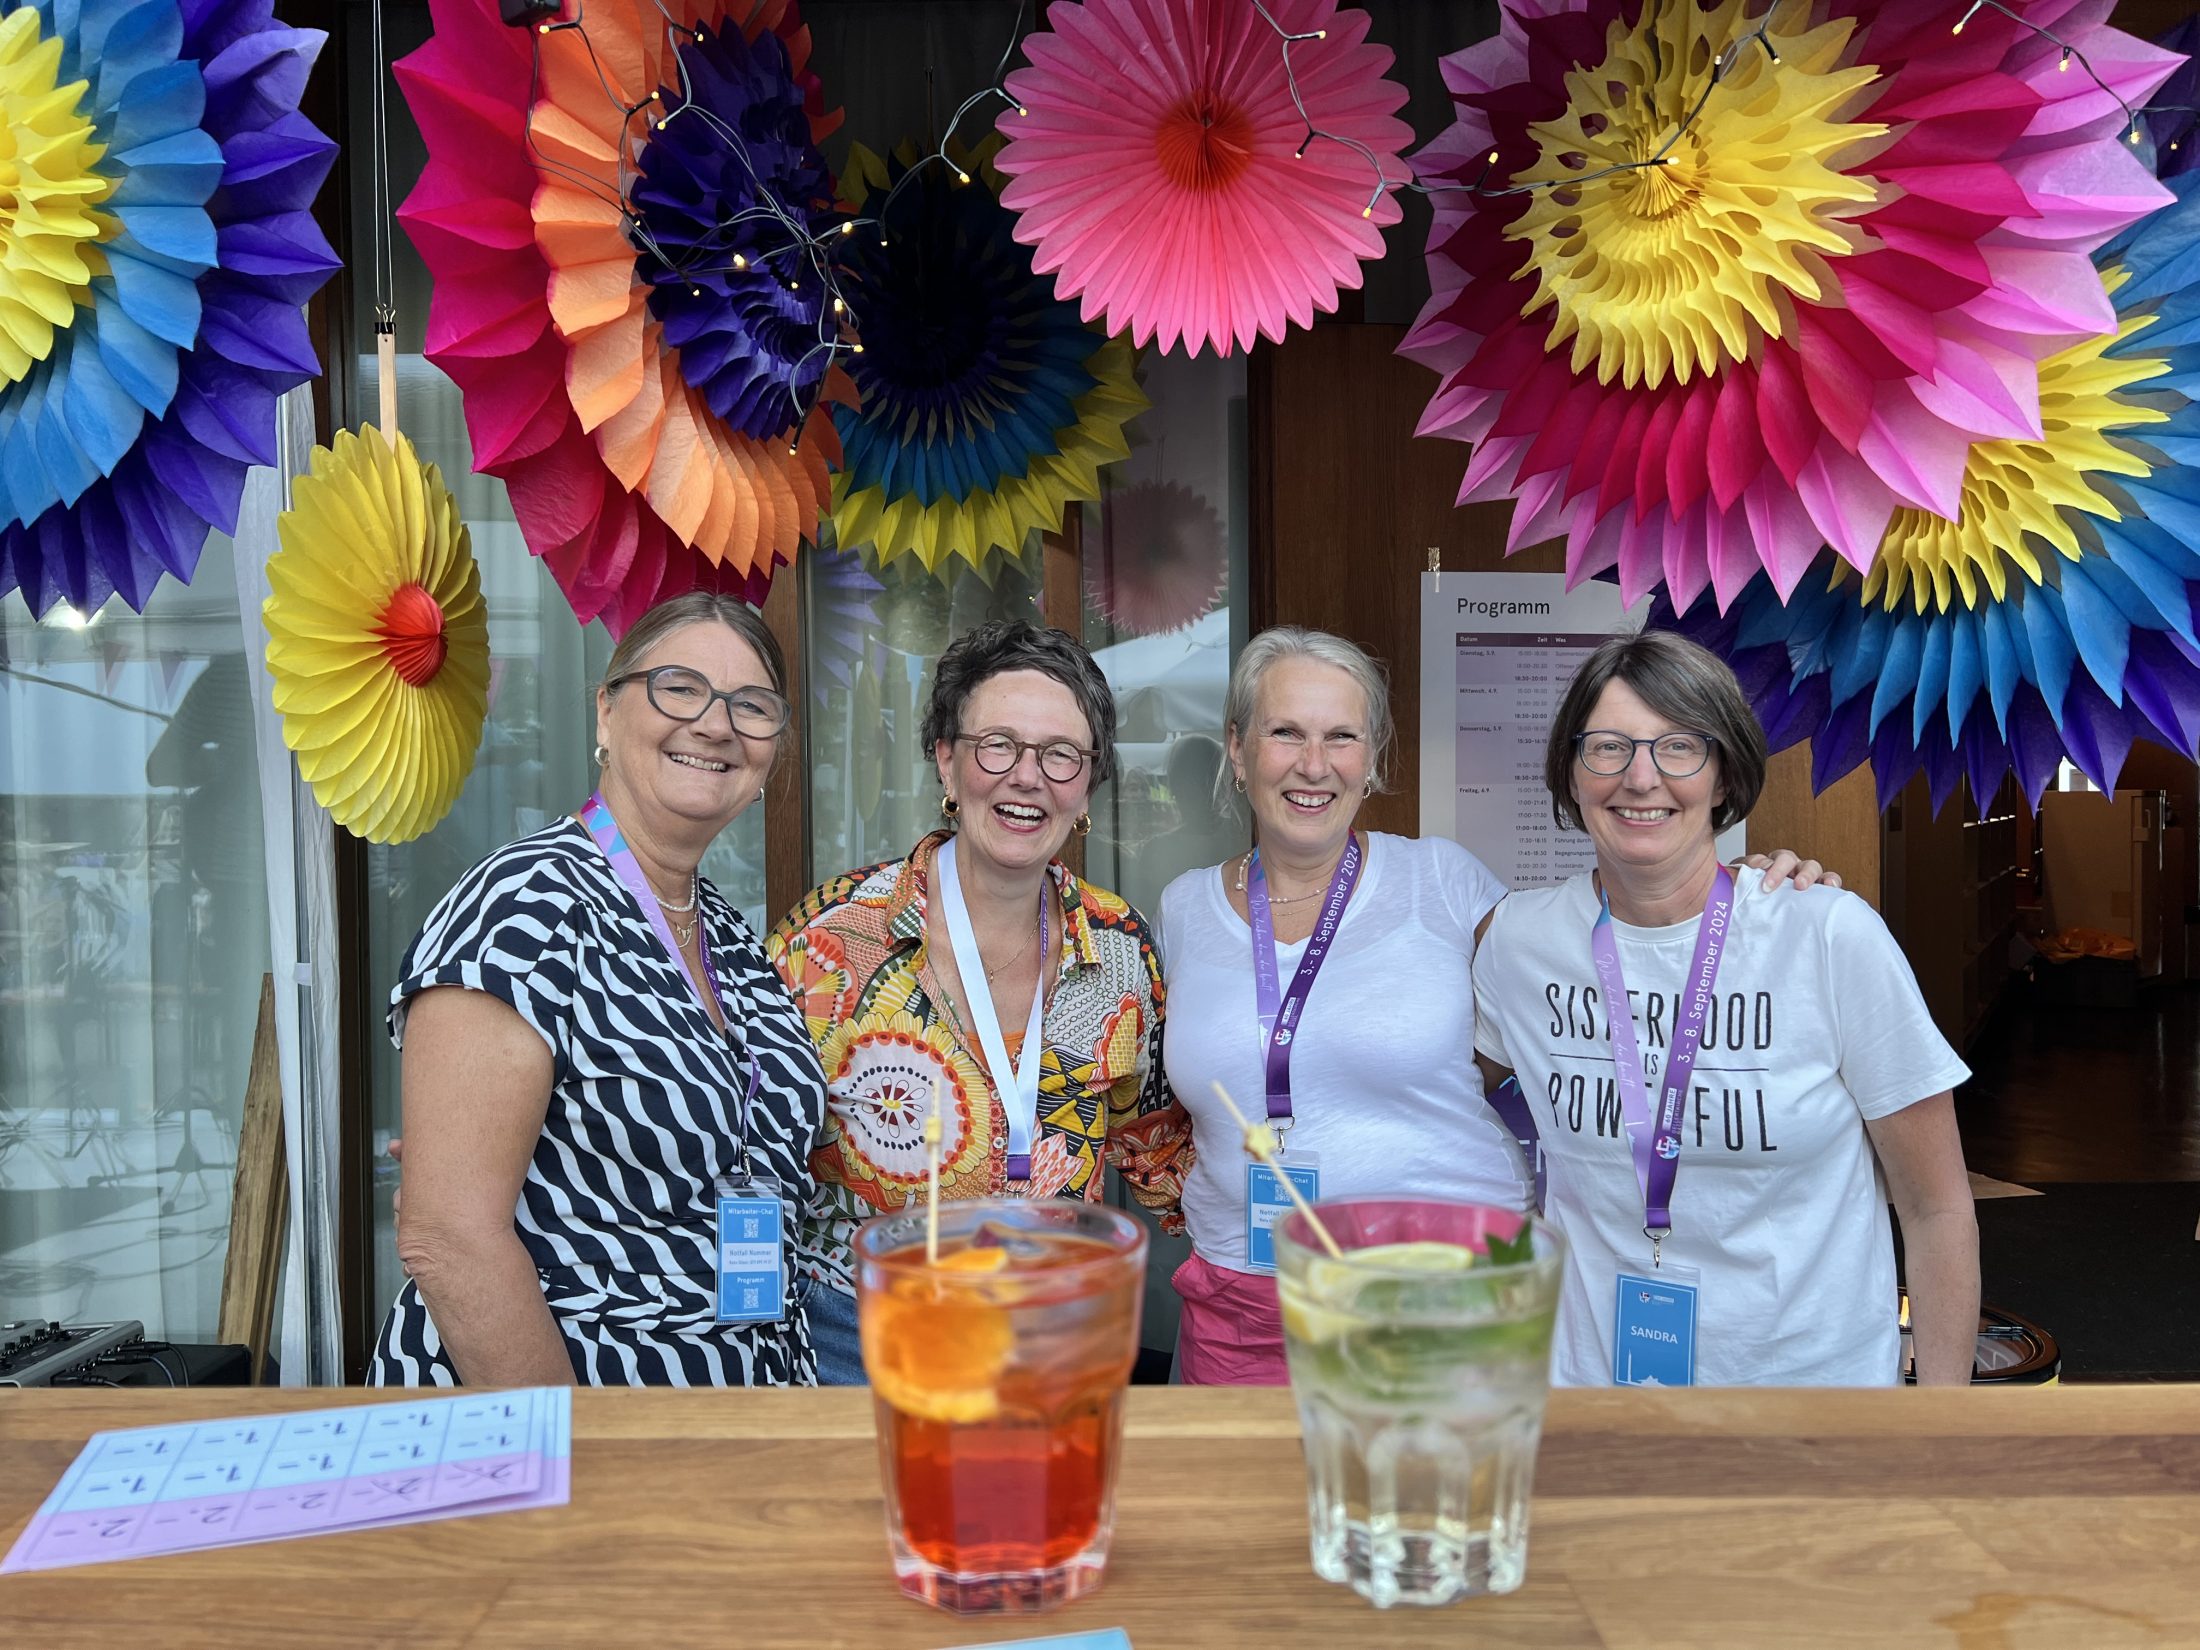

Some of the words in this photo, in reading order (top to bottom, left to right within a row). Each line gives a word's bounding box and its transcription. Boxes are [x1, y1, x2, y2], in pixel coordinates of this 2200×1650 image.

[1457, 598, 1550, 618] Programm
[1341, 845, 1360, 878] 2024
[1316, 879, 1348, 943] September
[1709, 900, 1729, 936] 2024
[1309, 945, 1324, 957] 8.
[1689, 940, 1719, 1020] September
[1545, 982, 1773, 1051] SISEROOD
[1684, 1025, 1699, 1038] 8.
[1644, 1053, 1658, 1076] IS
[1547, 1072, 1779, 1152] POWFUL
[1665, 1089, 1676, 1113] JAHRE
[1664, 1114, 1672, 1123] 60
[737, 1277, 765, 1285] Programm
[1630, 1325, 1678, 1345] SANDRA
